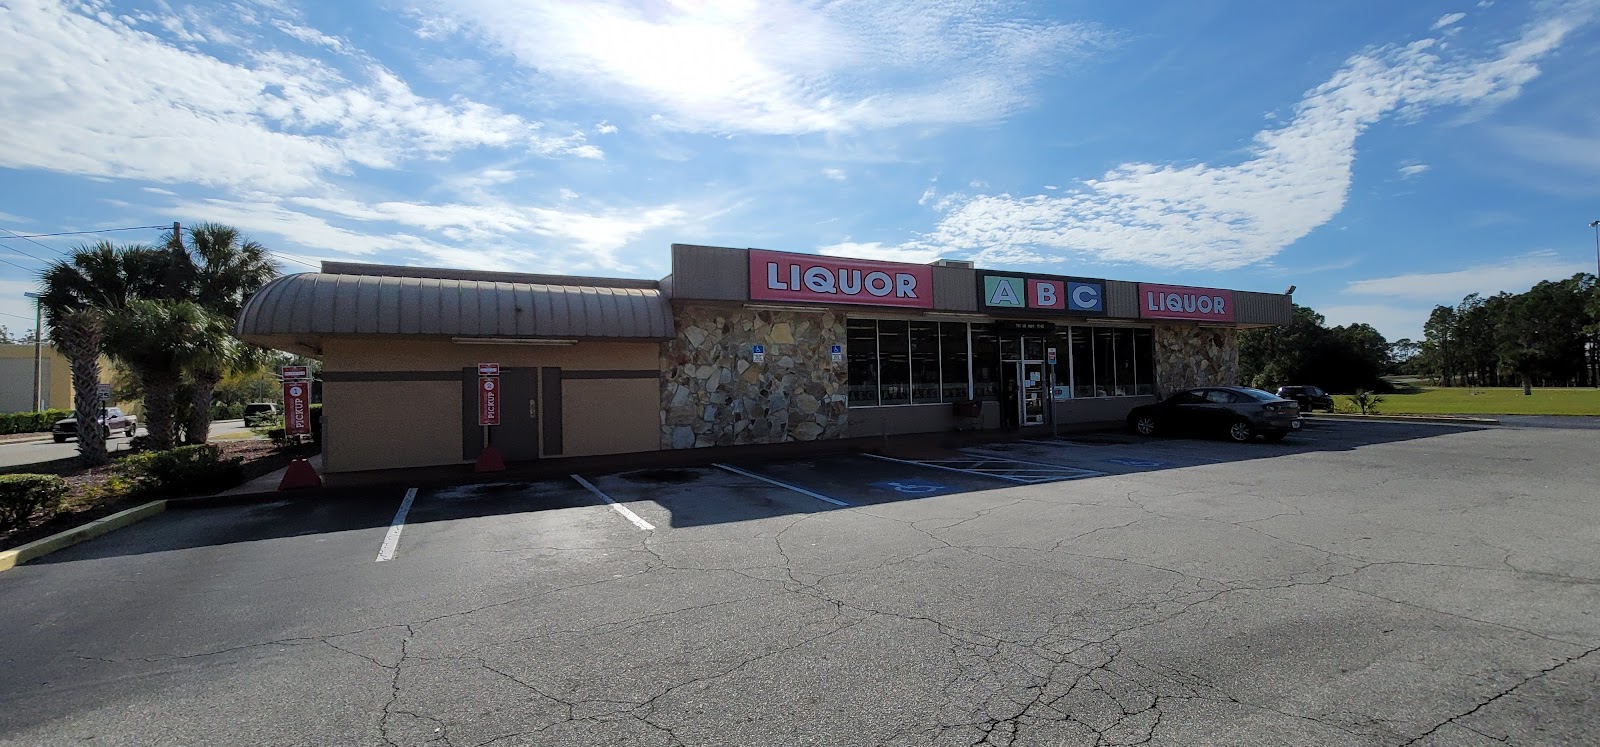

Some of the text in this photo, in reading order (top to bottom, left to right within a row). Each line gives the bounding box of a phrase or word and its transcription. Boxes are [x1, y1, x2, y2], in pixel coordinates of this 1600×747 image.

[766, 262, 919, 298] LIQUOR
[1147, 291, 1226, 315] LIQUOR
[295, 397, 304, 428] PICKUP
